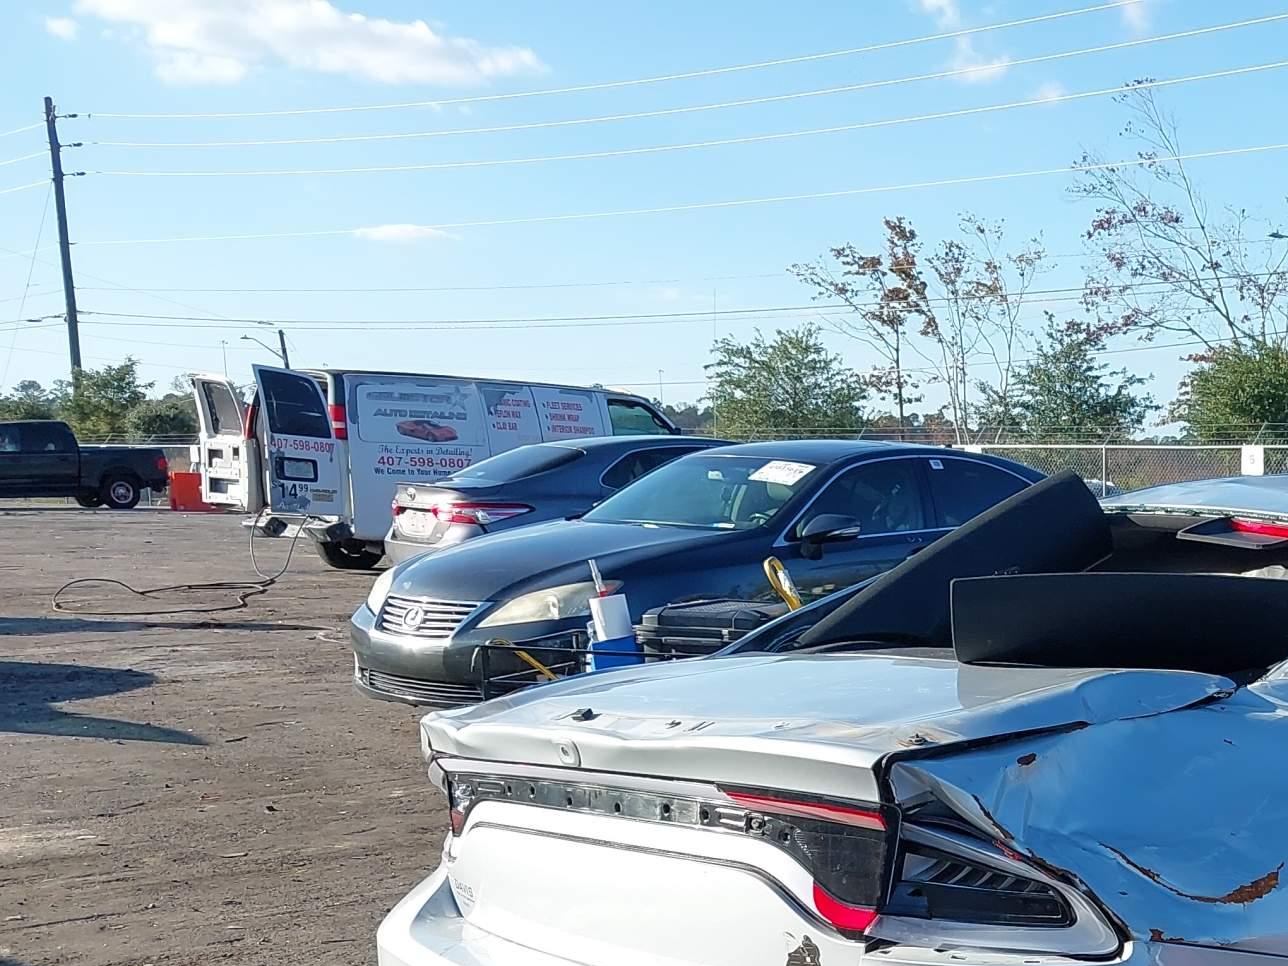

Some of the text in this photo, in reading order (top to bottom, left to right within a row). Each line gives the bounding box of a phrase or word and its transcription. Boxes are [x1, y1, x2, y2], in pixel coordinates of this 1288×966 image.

[561, 402, 583, 411] SERVICES
[373, 408, 408, 418] AUTO
[379, 444, 393, 454] The
[377, 455, 473, 469] 407-598-0807
[373, 467, 384, 475] We
[386, 467, 406, 476] Come
[408, 468, 415, 476] to
[416, 468, 431, 476] Your
